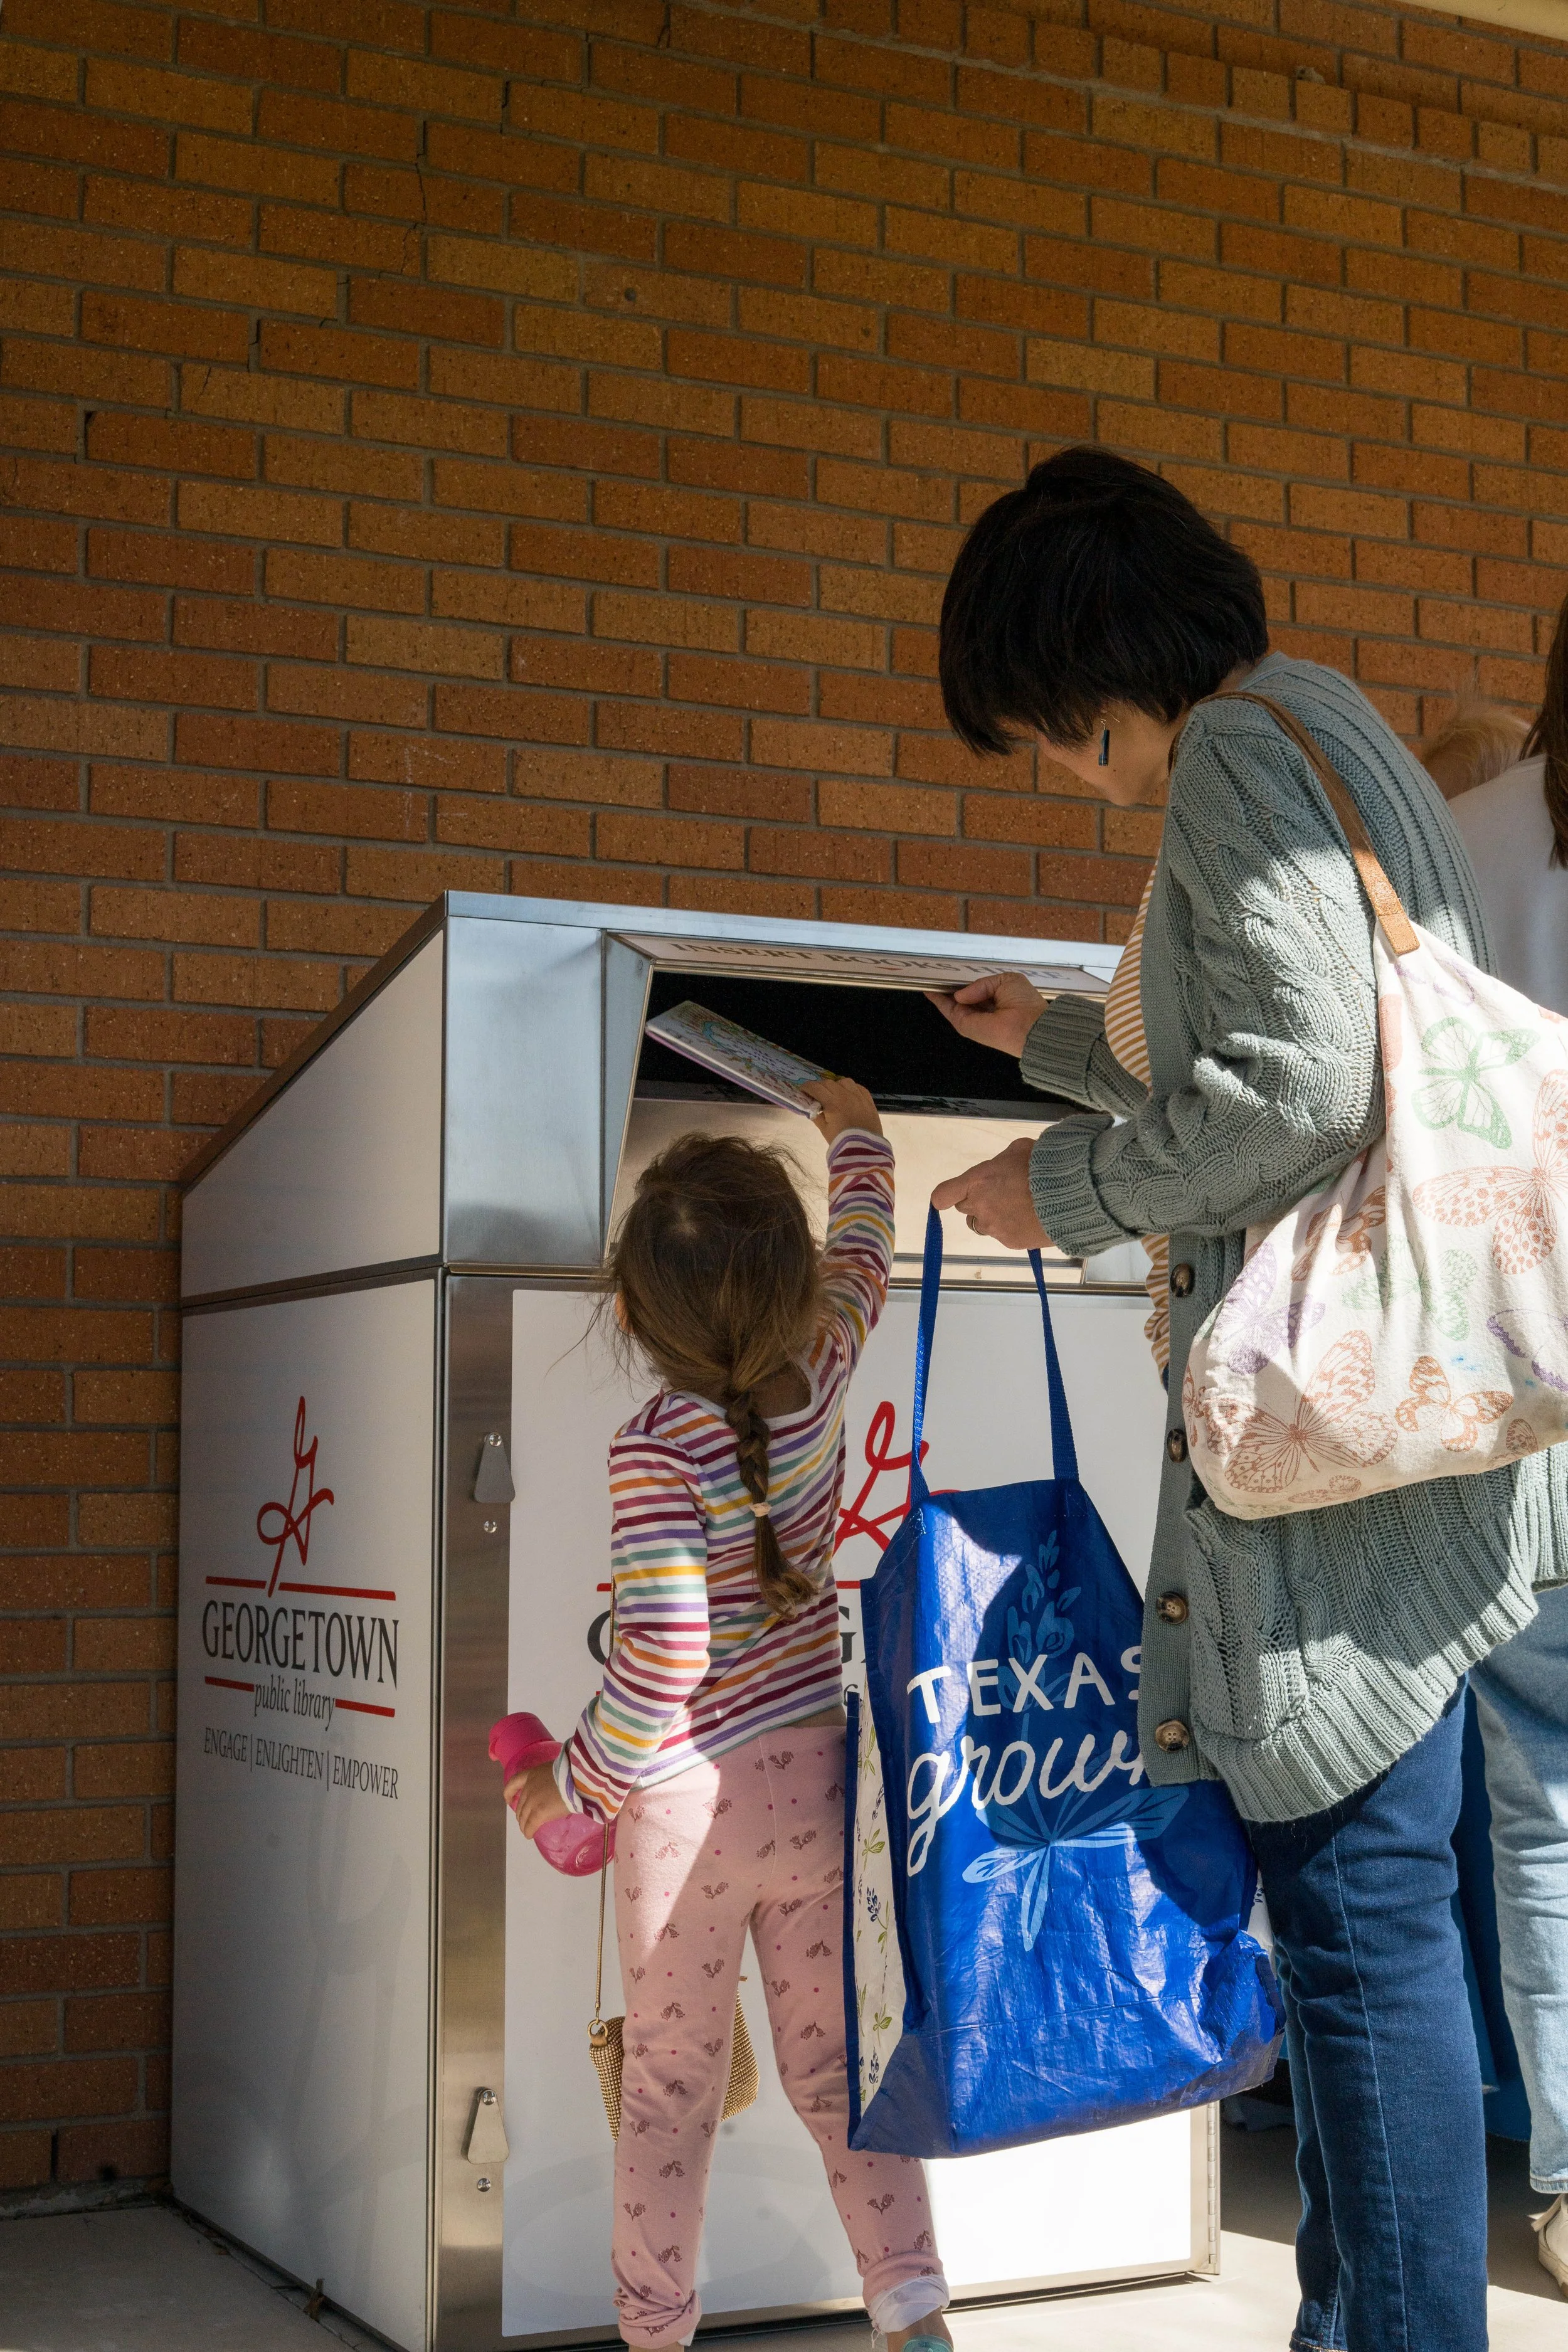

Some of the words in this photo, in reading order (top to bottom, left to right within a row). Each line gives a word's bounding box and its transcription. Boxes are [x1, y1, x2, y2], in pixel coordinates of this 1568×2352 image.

[670, 943, 813, 960] INSERT
[822, 953, 961, 972] BOOKS
[202, 1599, 399, 1690] GEORGETOWN
[254, 1673, 290, 1718] public
[294, 1678, 335, 1732] library
[204, 1727, 248, 1762] ENGAGE
[255, 1738, 324, 1781] ENLIGHTEN
[333, 1755, 398, 1799] EMPOWER
[907, 1729, 1145, 1877] grow
